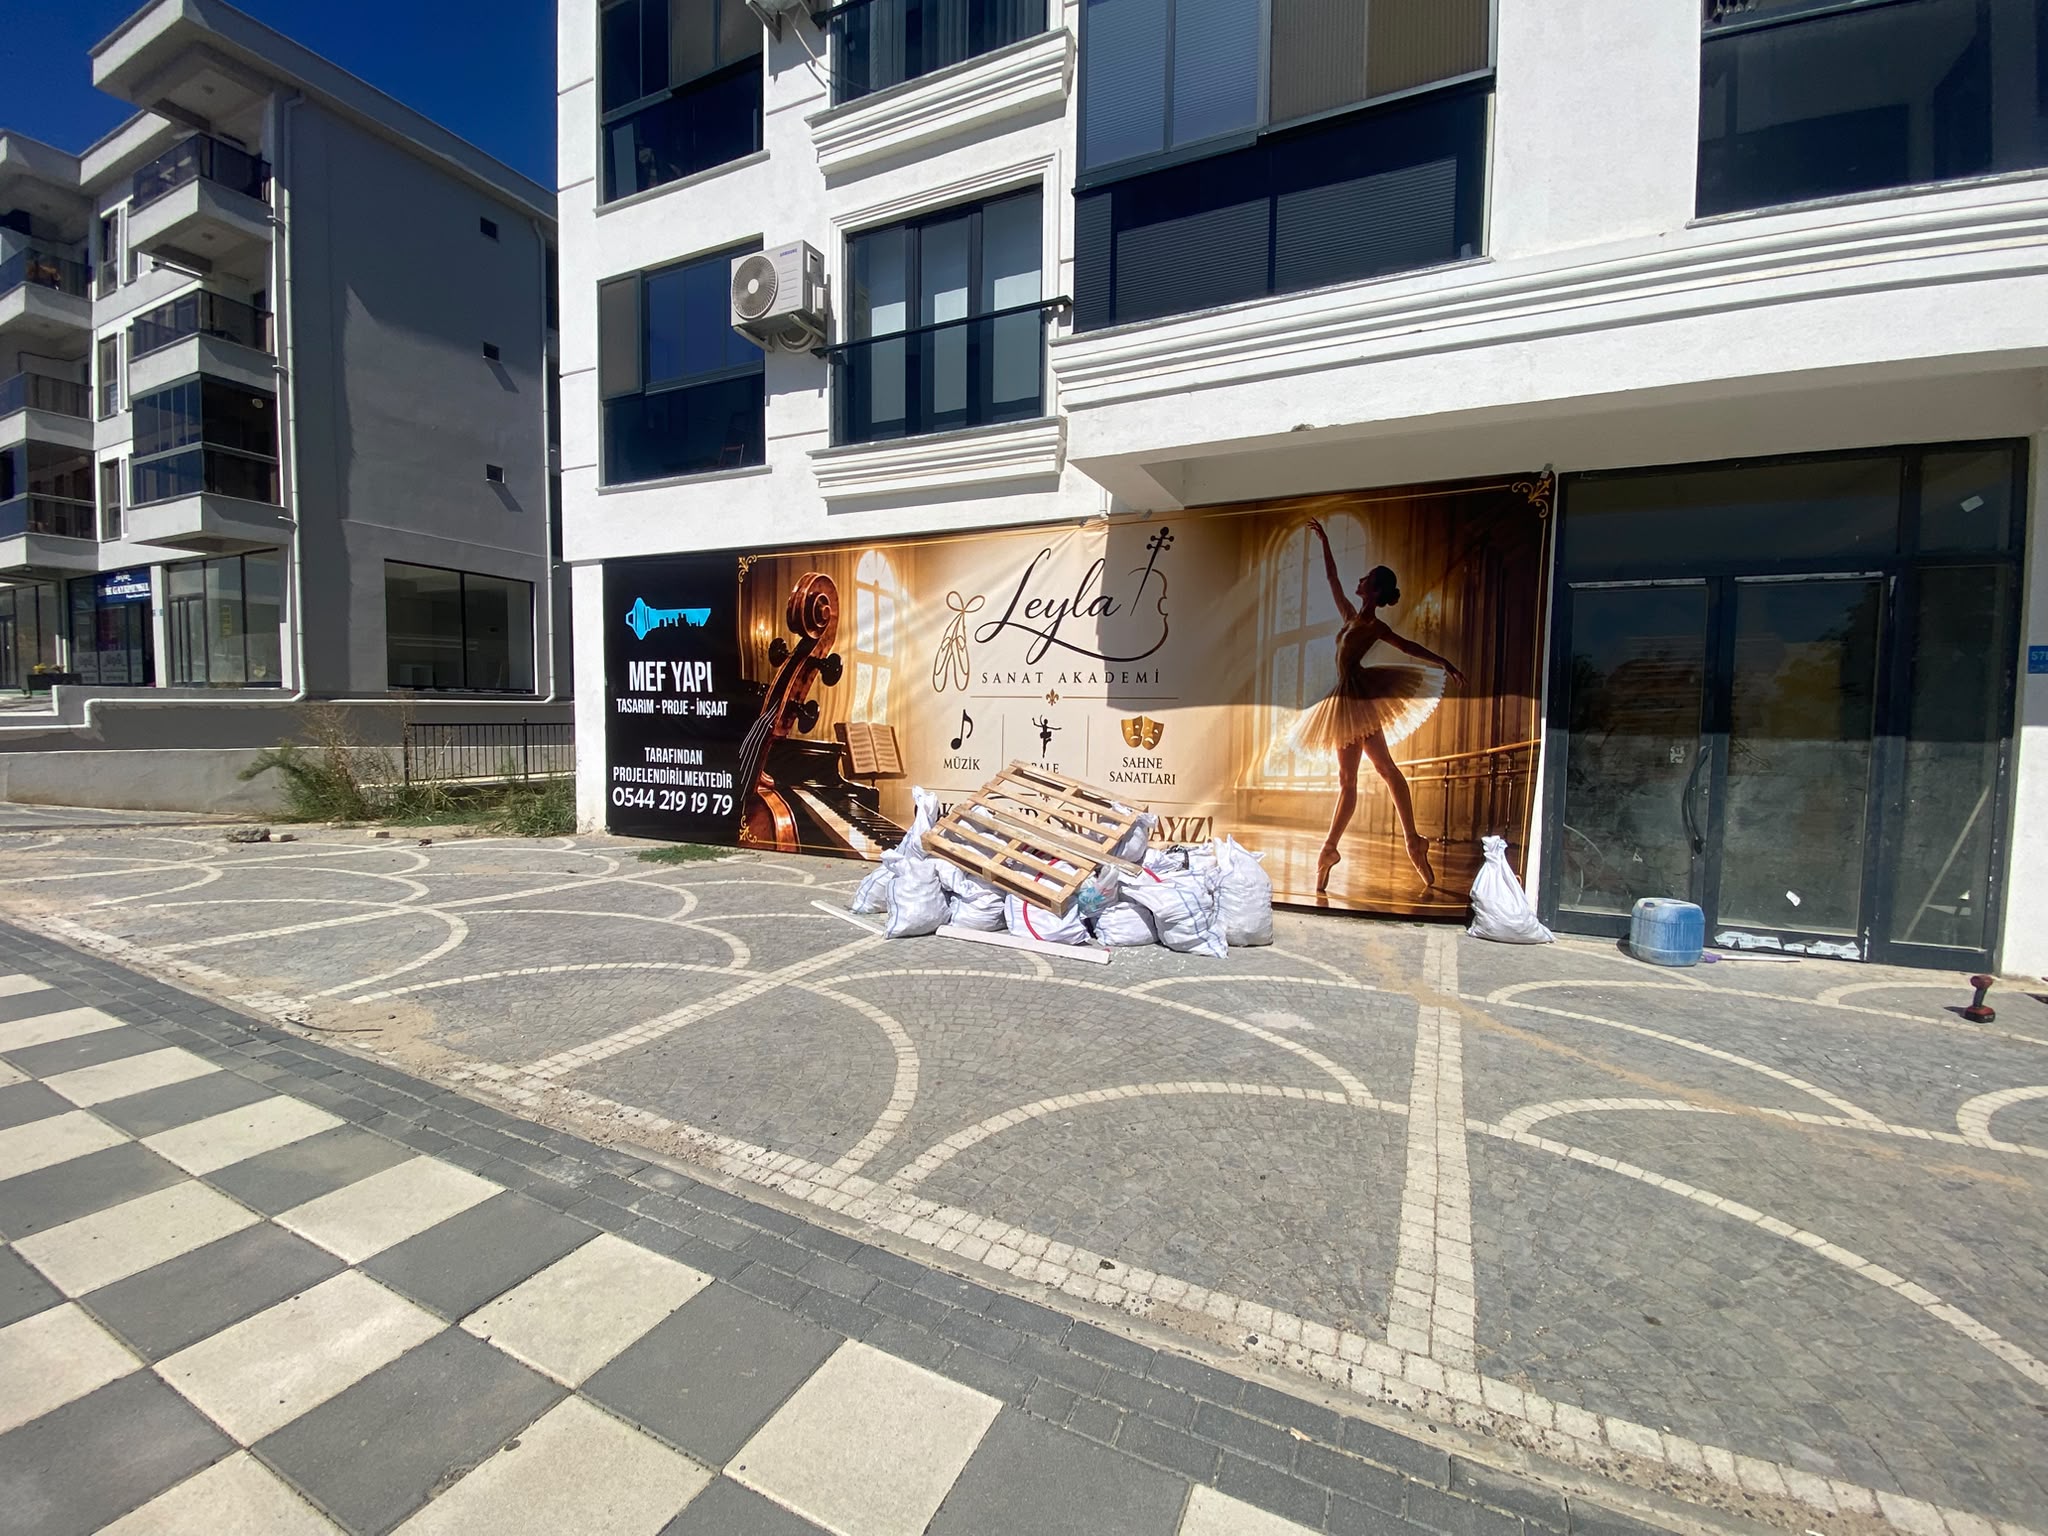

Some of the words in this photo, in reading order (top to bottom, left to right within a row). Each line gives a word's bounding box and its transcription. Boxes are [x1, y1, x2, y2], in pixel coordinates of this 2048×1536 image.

[975, 548, 1122, 664] Leyla
[629, 661, 667, 692] MEF
[671, 661, 713, 693] YAPI
[981, 671, 1044, 684] SANAT
[1058, 668, 1160, 684] AKADEMİ
[616, 698, 654, 714] TASARIM
[662, 699, 689, 715] PROJE
[696, 697, 728, 718] İNŞAAT
[644, 747, 703, 765] TARAFINDAN
[943, 756, 981, 771] MÜZİK
[1122, 756, 1163, 770] SAHNE
[613, 766, 733, 789] PROJELENDİRİLMEKTEDİR
[1109, 771, 1176, 785] SANATLARI
[612, 786, 656, 809] 0544
[659, 789, 687, 812] 219
[690, 792, 708, 814] 19
[712, 794, 734, 816] 79
